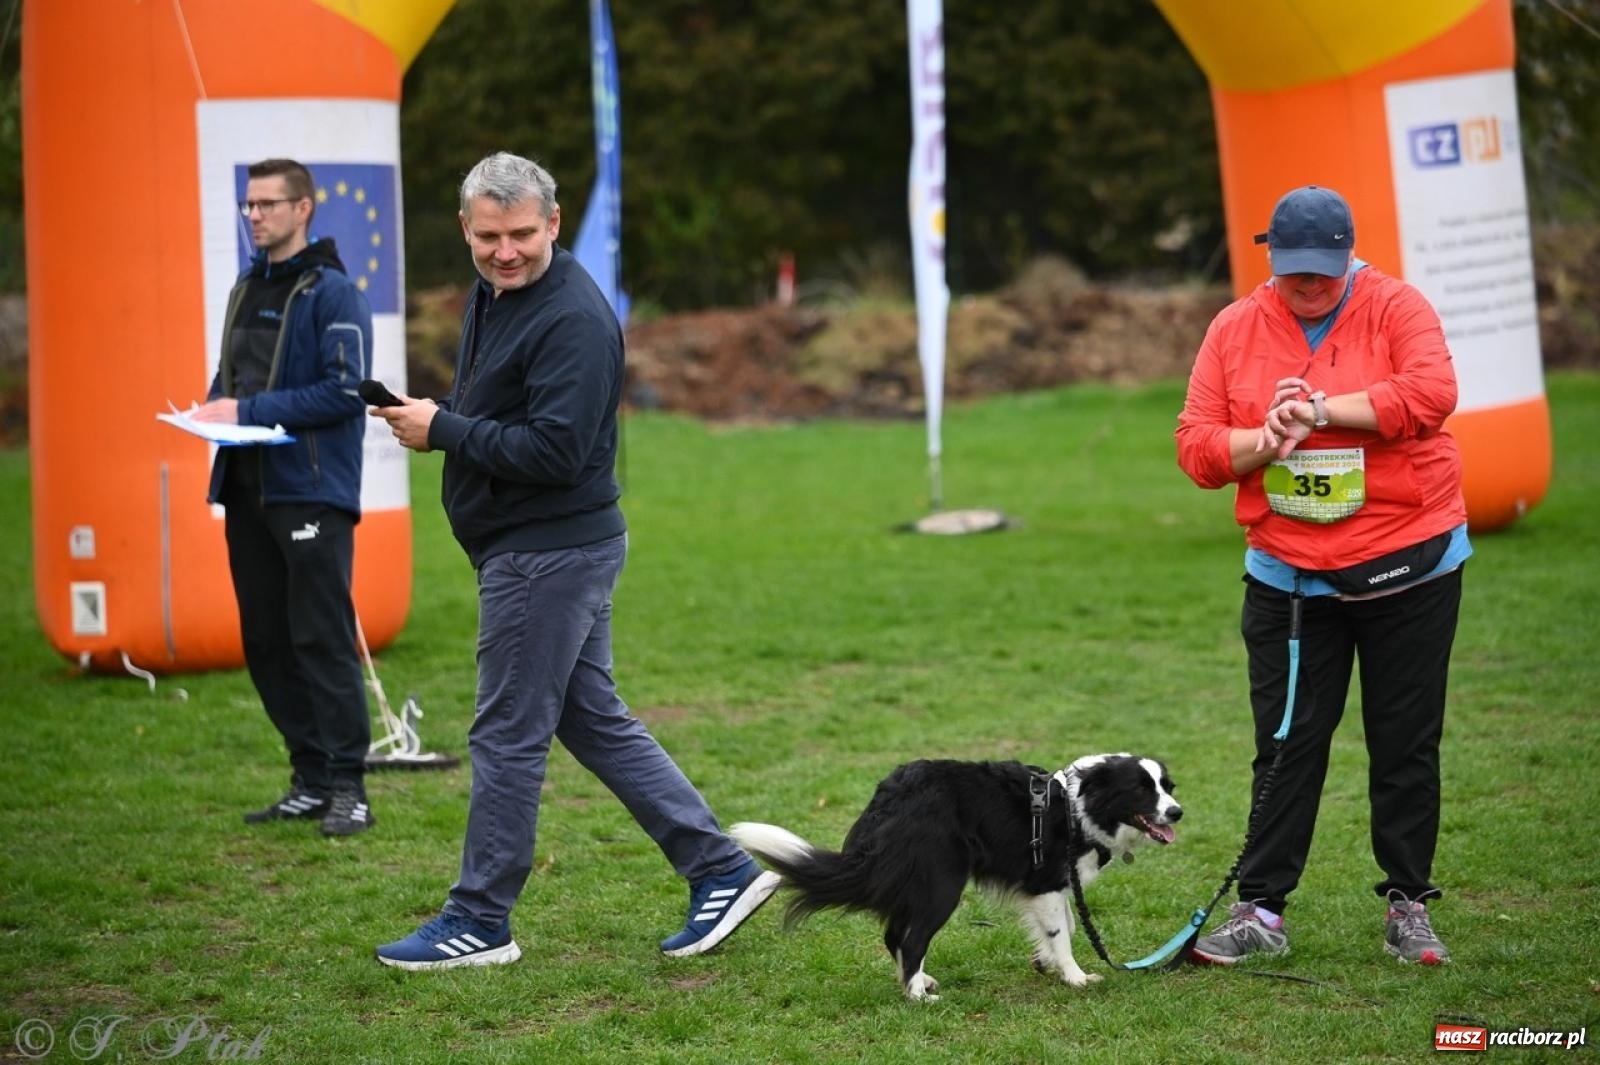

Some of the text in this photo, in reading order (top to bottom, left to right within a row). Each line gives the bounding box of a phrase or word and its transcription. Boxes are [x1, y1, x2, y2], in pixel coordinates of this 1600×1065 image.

[1413, 126, 1458, 165] CZ
[1300, 453, 1361, 461] DOGTREKKING
[1294, 474, 1331, 497] 35
